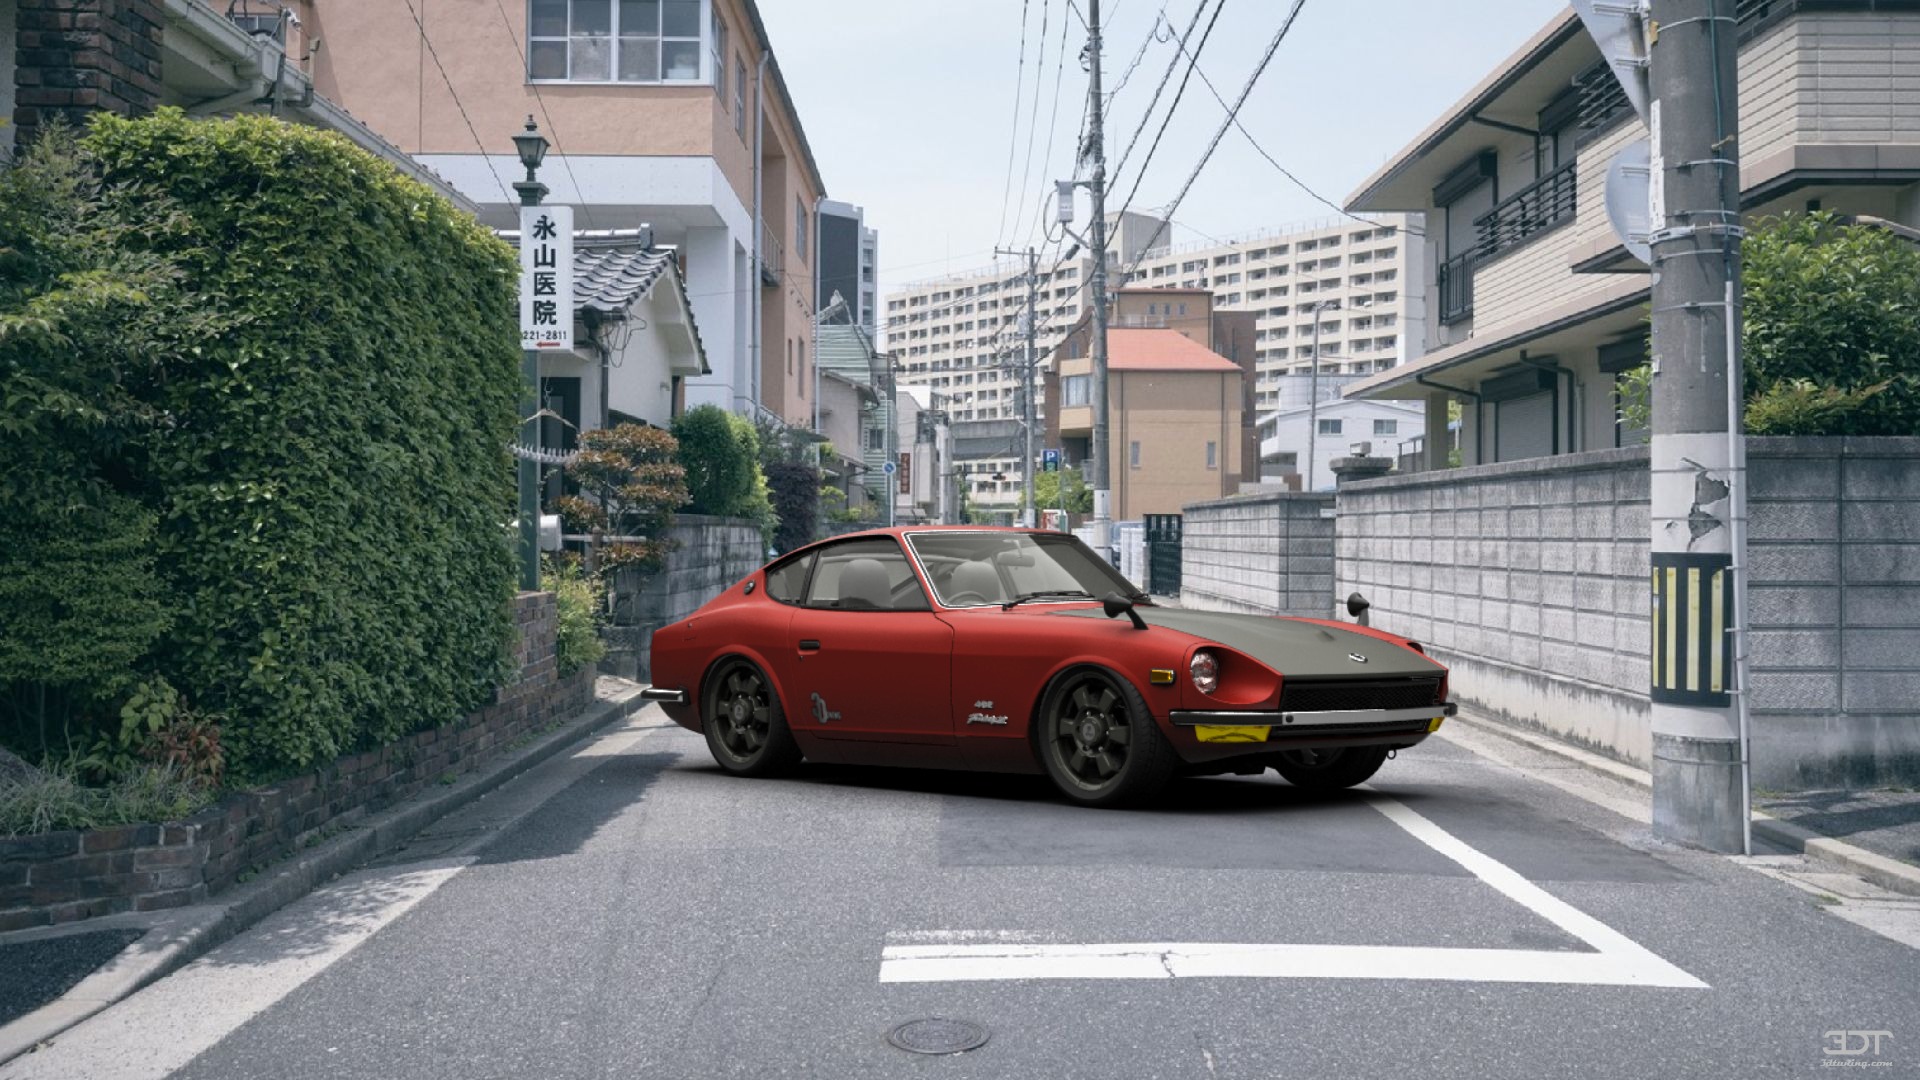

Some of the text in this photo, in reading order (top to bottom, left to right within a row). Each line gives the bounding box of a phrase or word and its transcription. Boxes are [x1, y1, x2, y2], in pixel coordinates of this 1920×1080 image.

[532, 214, 557, 326] 永山医院
[523, 330, 567, 340] 221-2811
[1046, 451, 1056, 461] P
